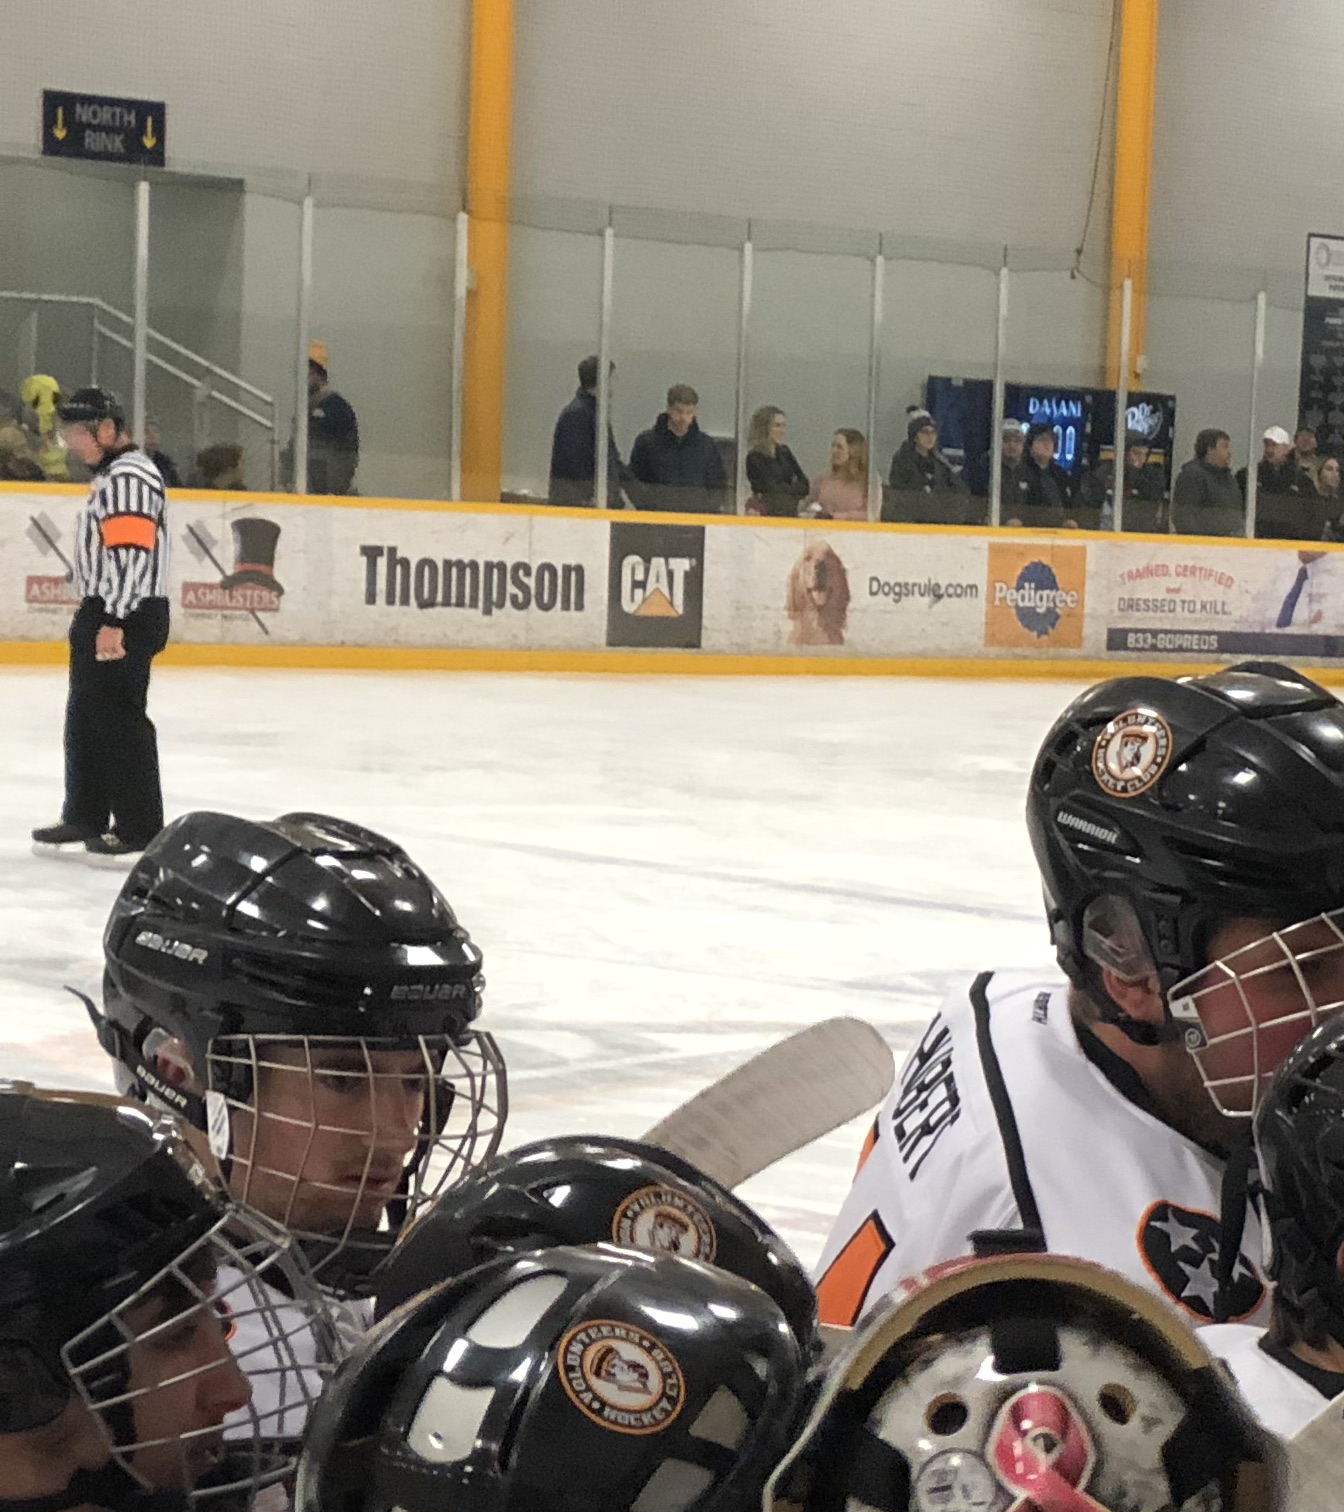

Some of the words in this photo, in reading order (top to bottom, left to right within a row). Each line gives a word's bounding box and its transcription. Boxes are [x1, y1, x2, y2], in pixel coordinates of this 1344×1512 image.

[75, 103, 135, 127] NORTH
[85, 130, 125, 152] RINK
[1029, 397, 1082, 418] DASANI
[359, 544, 585, 617] Thompson
[620, 554, 691, 617] CAT
[1175, 564, 1235, 588] CERTIFIED
[868, 576, 979, 604] Dogsrule.com
[994, 582, 1079, 614] Pedigree
[1118, 597, 1177, 614] DRESSED
[1180, 599, 1197, 614] TO
[1200, 600, 1233, 615] KILL.
